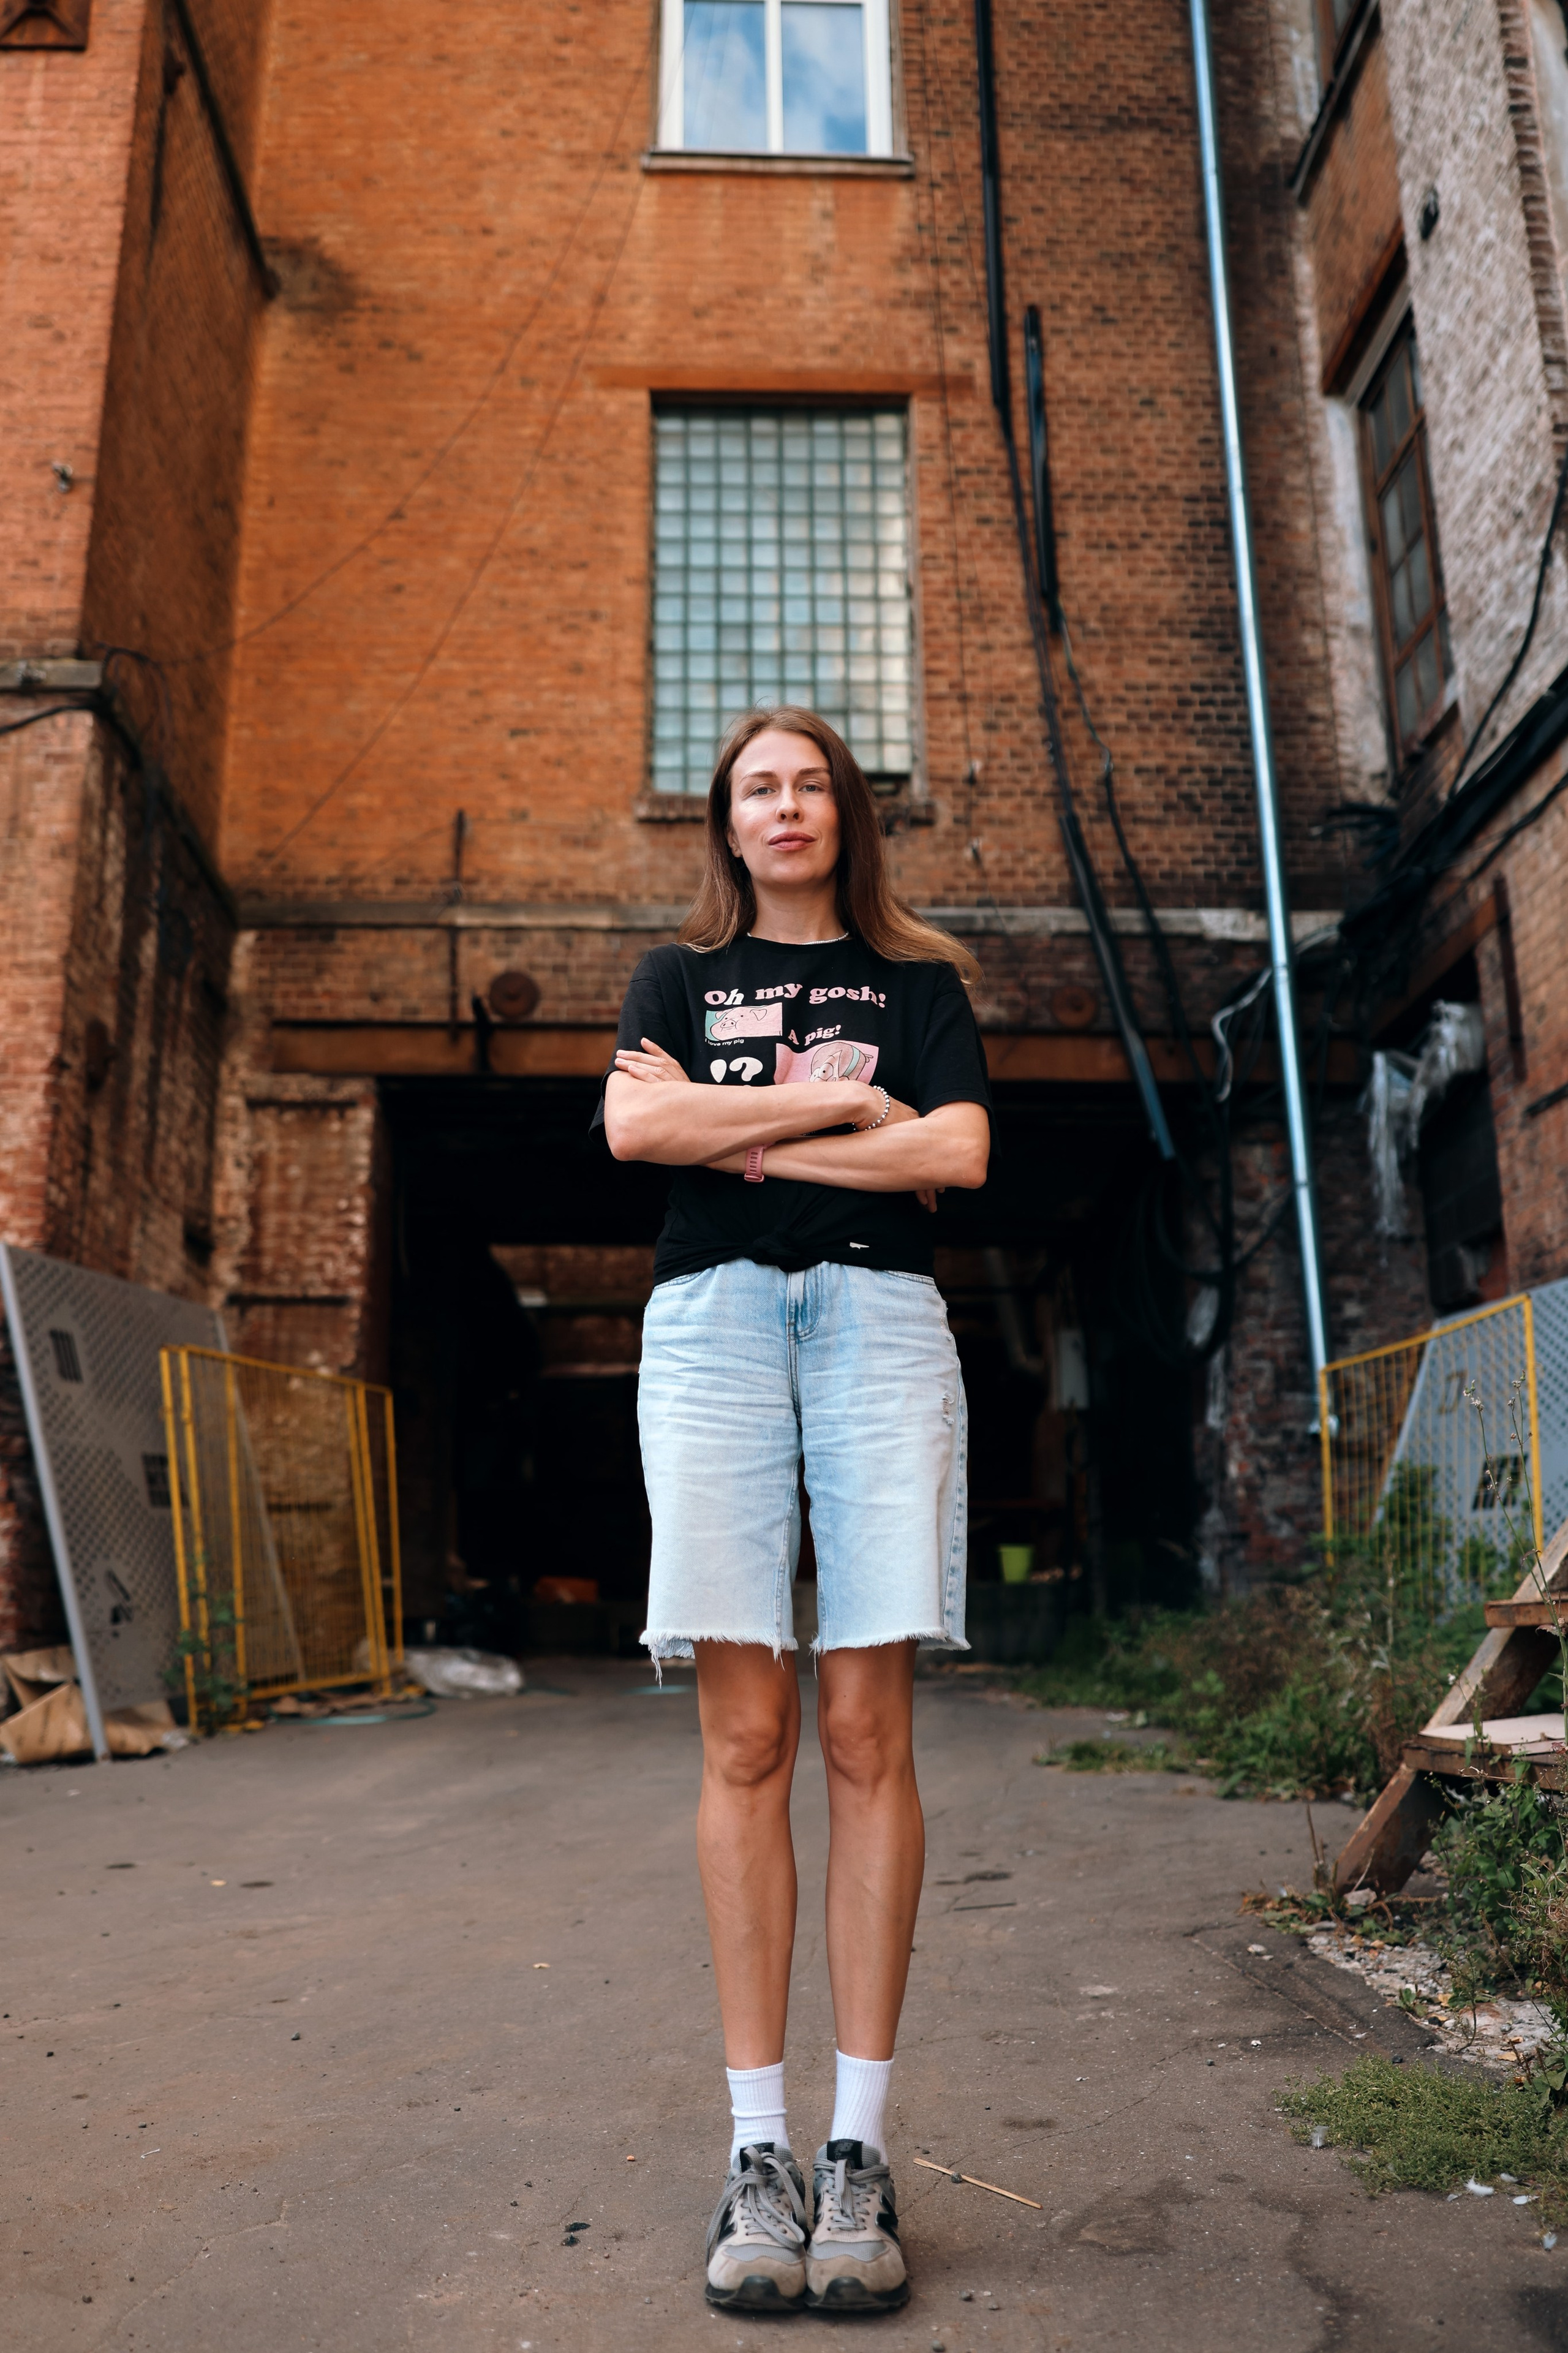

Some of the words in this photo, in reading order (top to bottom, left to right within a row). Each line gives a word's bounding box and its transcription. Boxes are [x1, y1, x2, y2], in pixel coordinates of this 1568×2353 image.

[704, 989, 744, 1005] Oh
[755, 983, 802, 1000] my
[809, 986, 886, 1008] gosh!
[788, 1029, 799, 1046] A
[804, 1024, 842, 1046] pig!
